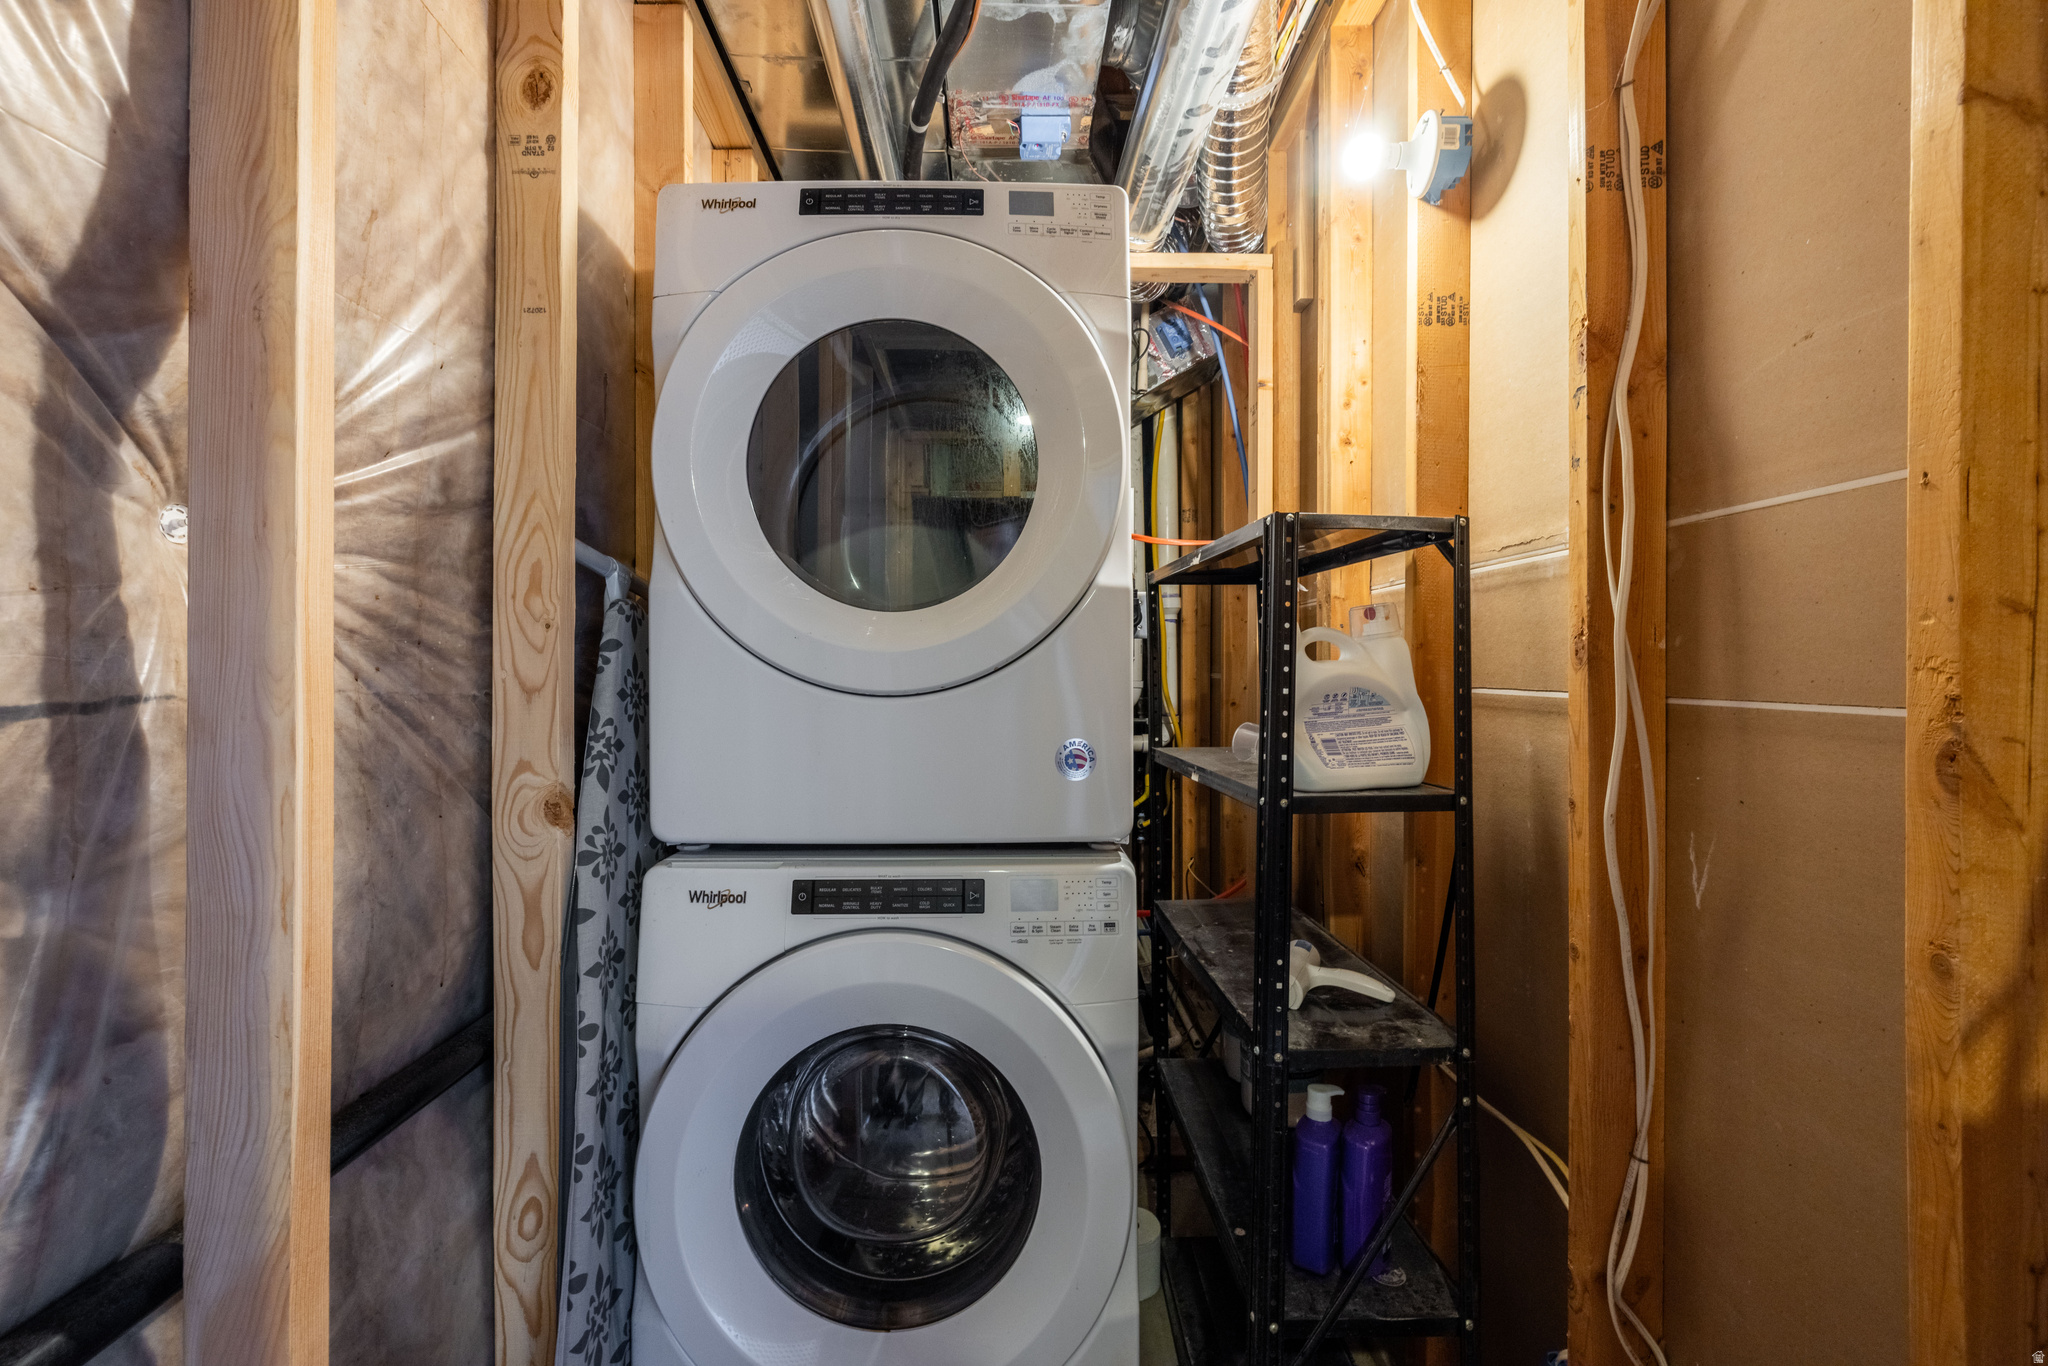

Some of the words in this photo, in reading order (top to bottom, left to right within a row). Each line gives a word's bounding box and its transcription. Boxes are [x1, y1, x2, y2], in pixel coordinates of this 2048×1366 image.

[1606, 149, 1615, 178] STUD
[1641, 145, 1650, 175] STUD
[701, 197, 757, 213] Whirlpool
[1063, 740, 1095, 763] AMERICA
[688, 889, 747, 909] Whirlpool
